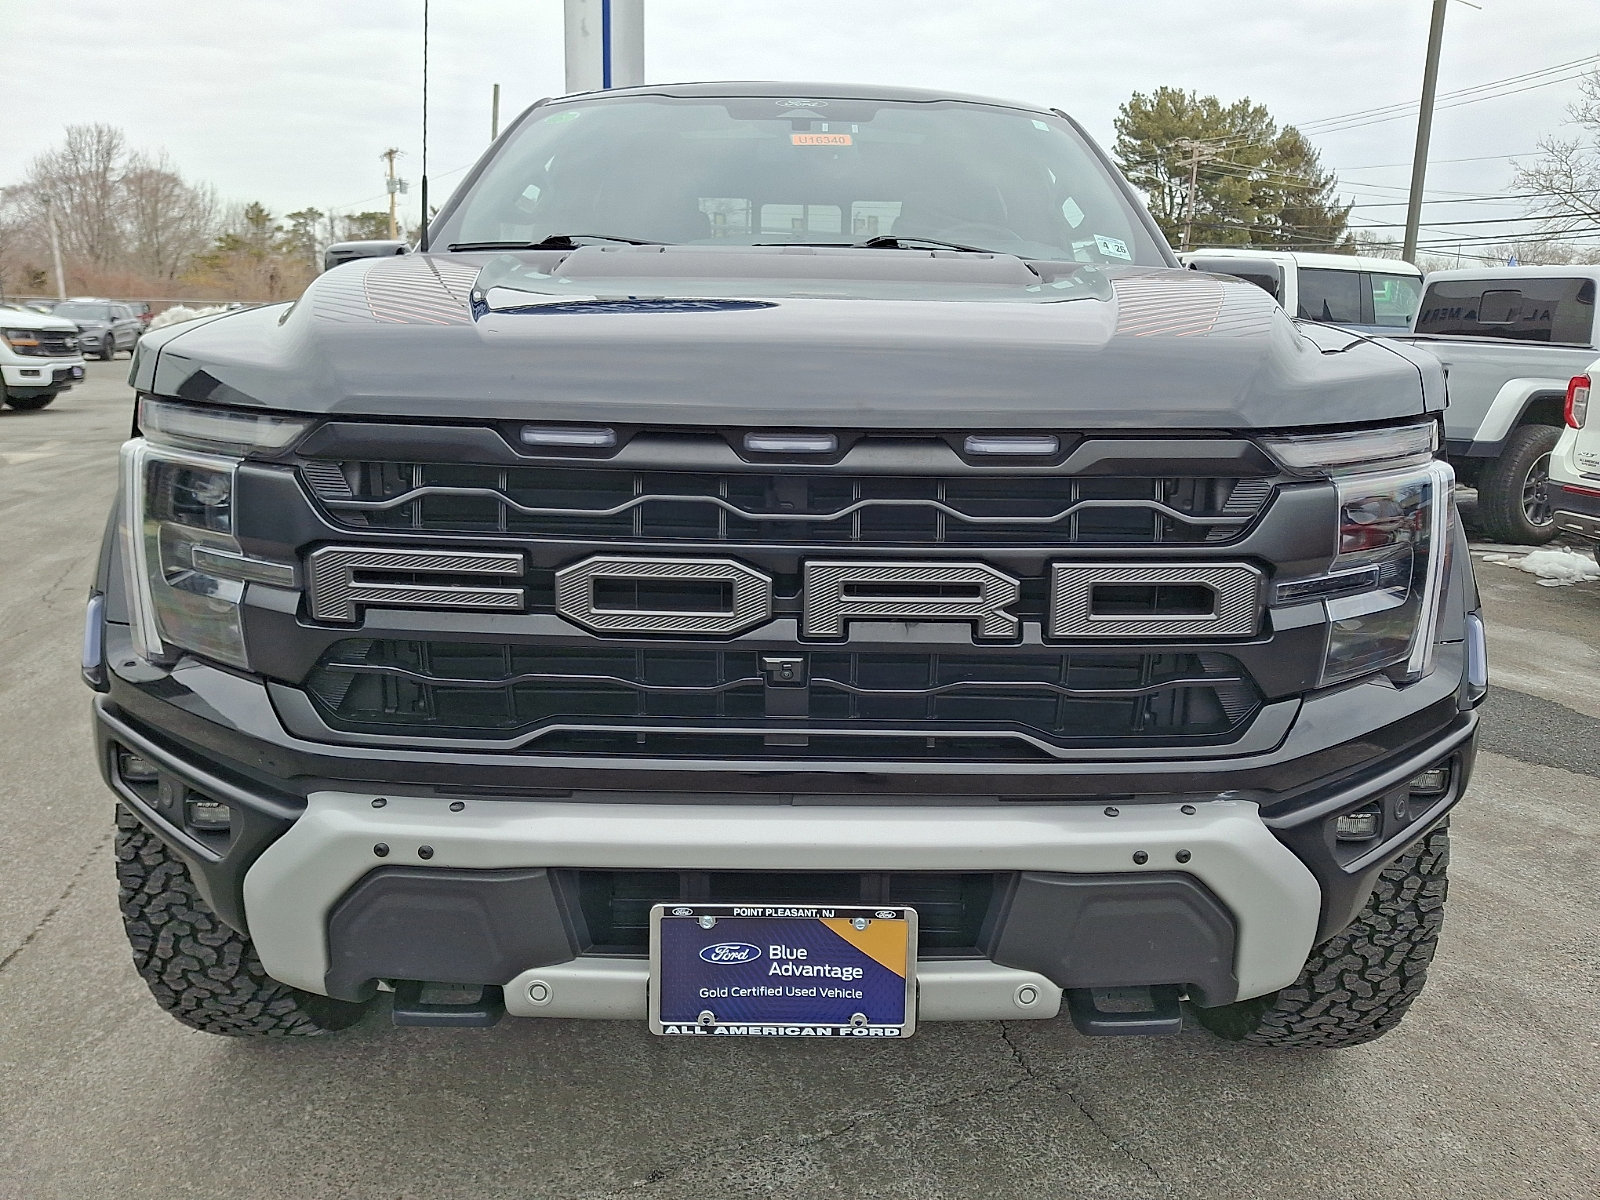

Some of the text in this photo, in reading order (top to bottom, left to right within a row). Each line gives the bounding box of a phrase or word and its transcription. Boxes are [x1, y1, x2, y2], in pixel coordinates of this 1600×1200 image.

[799, 136, 845, 144] U16340
[1114, 245, 1126, 253] 26
[307, 545, 1265, 640] FORD
[733, 907, 835, 919] POINT PLEASANT, NJ
[711, 945, 750, 961] Ford
[769, 944, 808, 960] Blue
[768, 961, 864, 981] Advantage
[699, 985, 863, 999] Gold Certified Used Vehicle
[664, 1025, 901, 1037] ALL AMERICAN FORD
